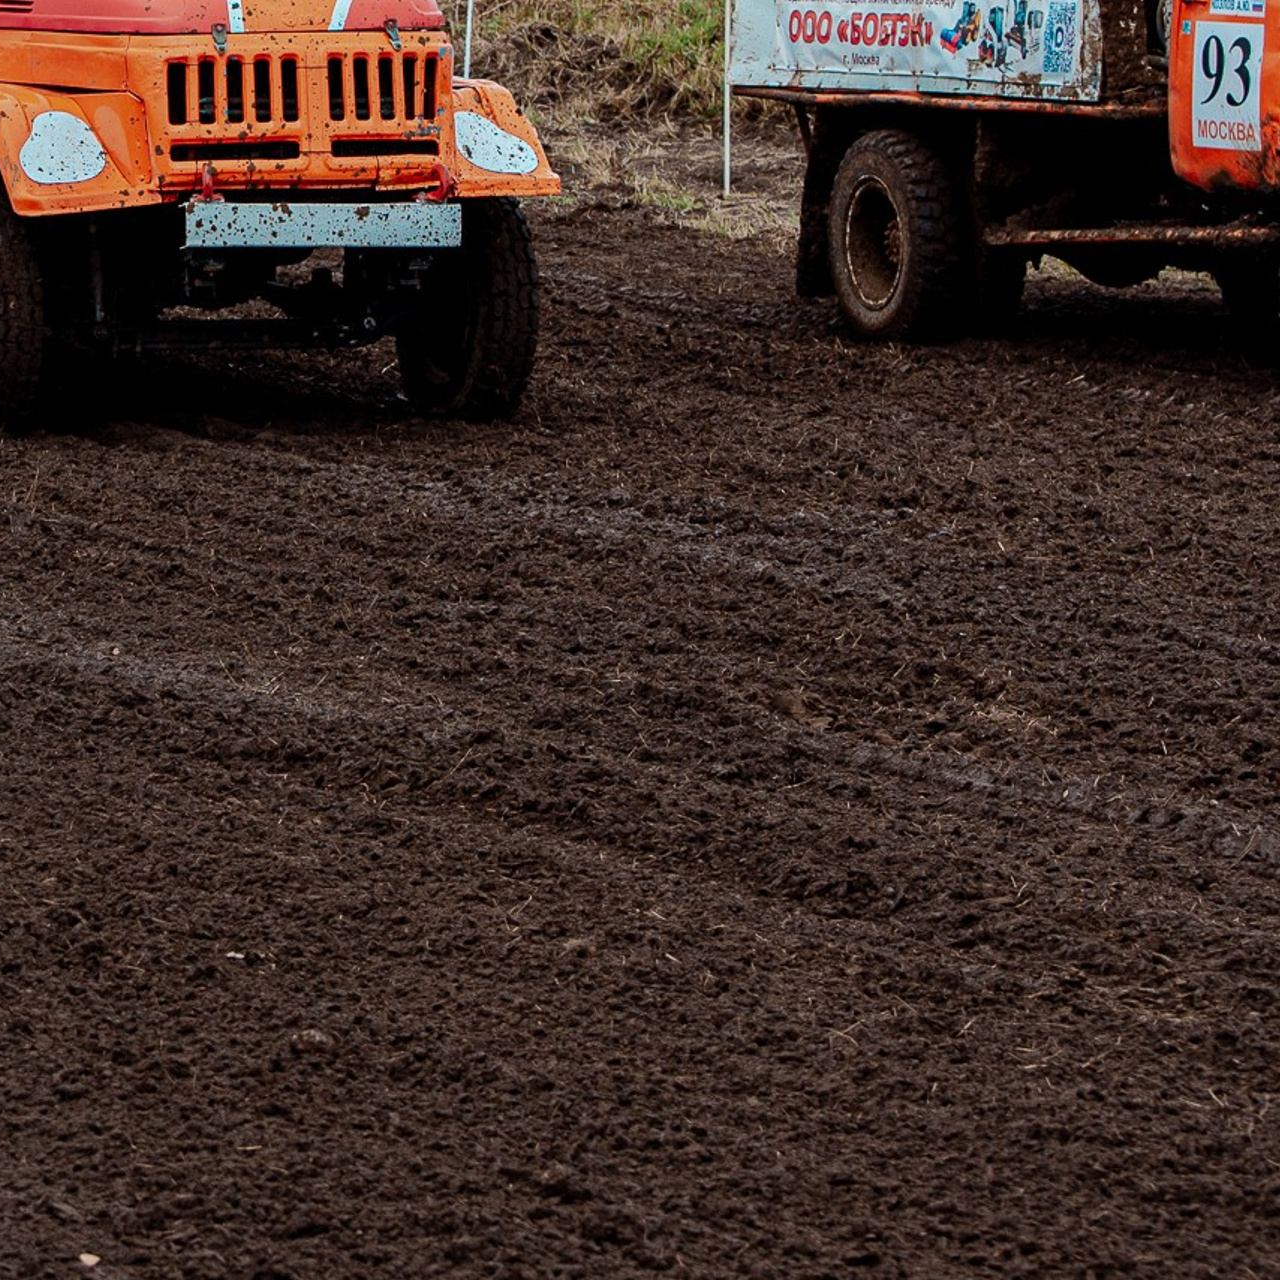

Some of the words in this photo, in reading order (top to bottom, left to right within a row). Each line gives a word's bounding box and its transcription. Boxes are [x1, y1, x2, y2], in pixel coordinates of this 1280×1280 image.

[788, 9, 834, 44] ООО
[851, 52, 880, 66] Москва
[1200, 35, 1252, 108] 93
[1197, 119, 1256, 141] МОСКВА
